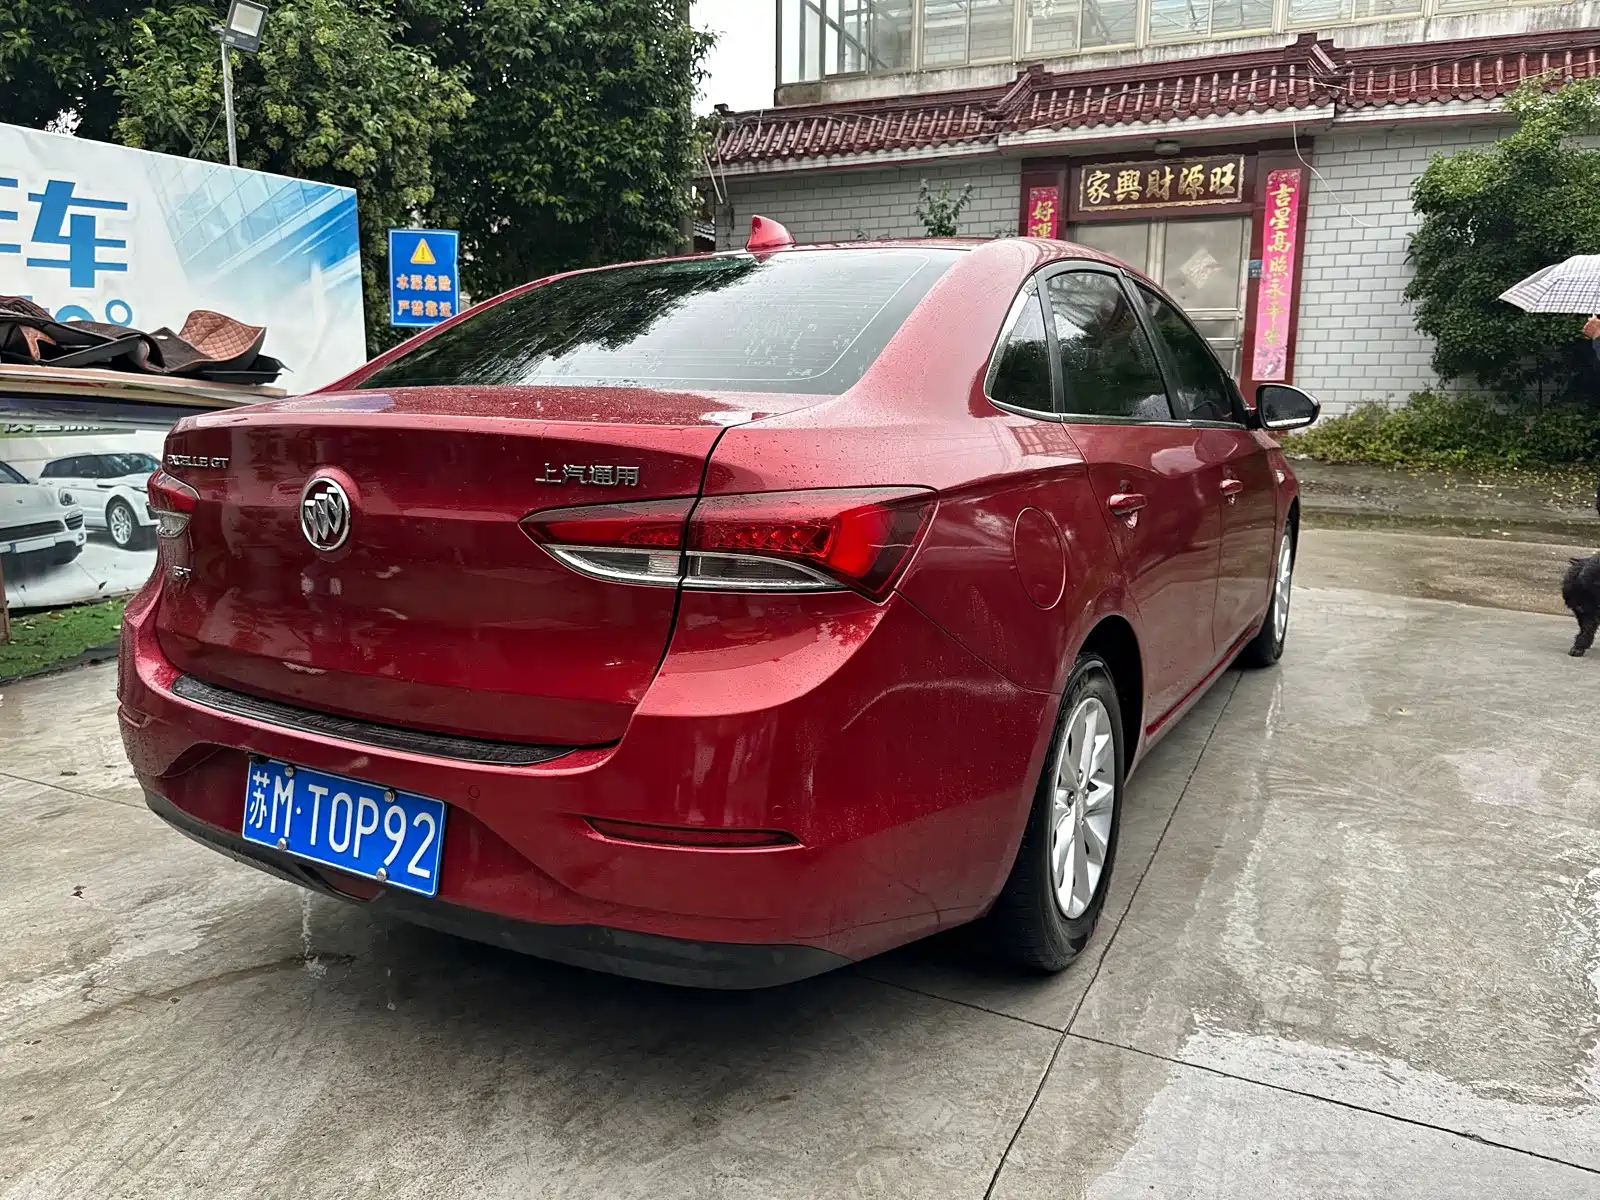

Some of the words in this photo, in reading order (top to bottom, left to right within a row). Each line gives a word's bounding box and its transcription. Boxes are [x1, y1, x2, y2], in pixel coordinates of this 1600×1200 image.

[1086, 162, 1236, 204] 家興財源旺
[0, 177, 128, 288] 车
[396, 273, 452, 291] 水深危险
[397, 300, 453, 317] 严禁靠近
[534, 462, 640, 486] 上汽通用
